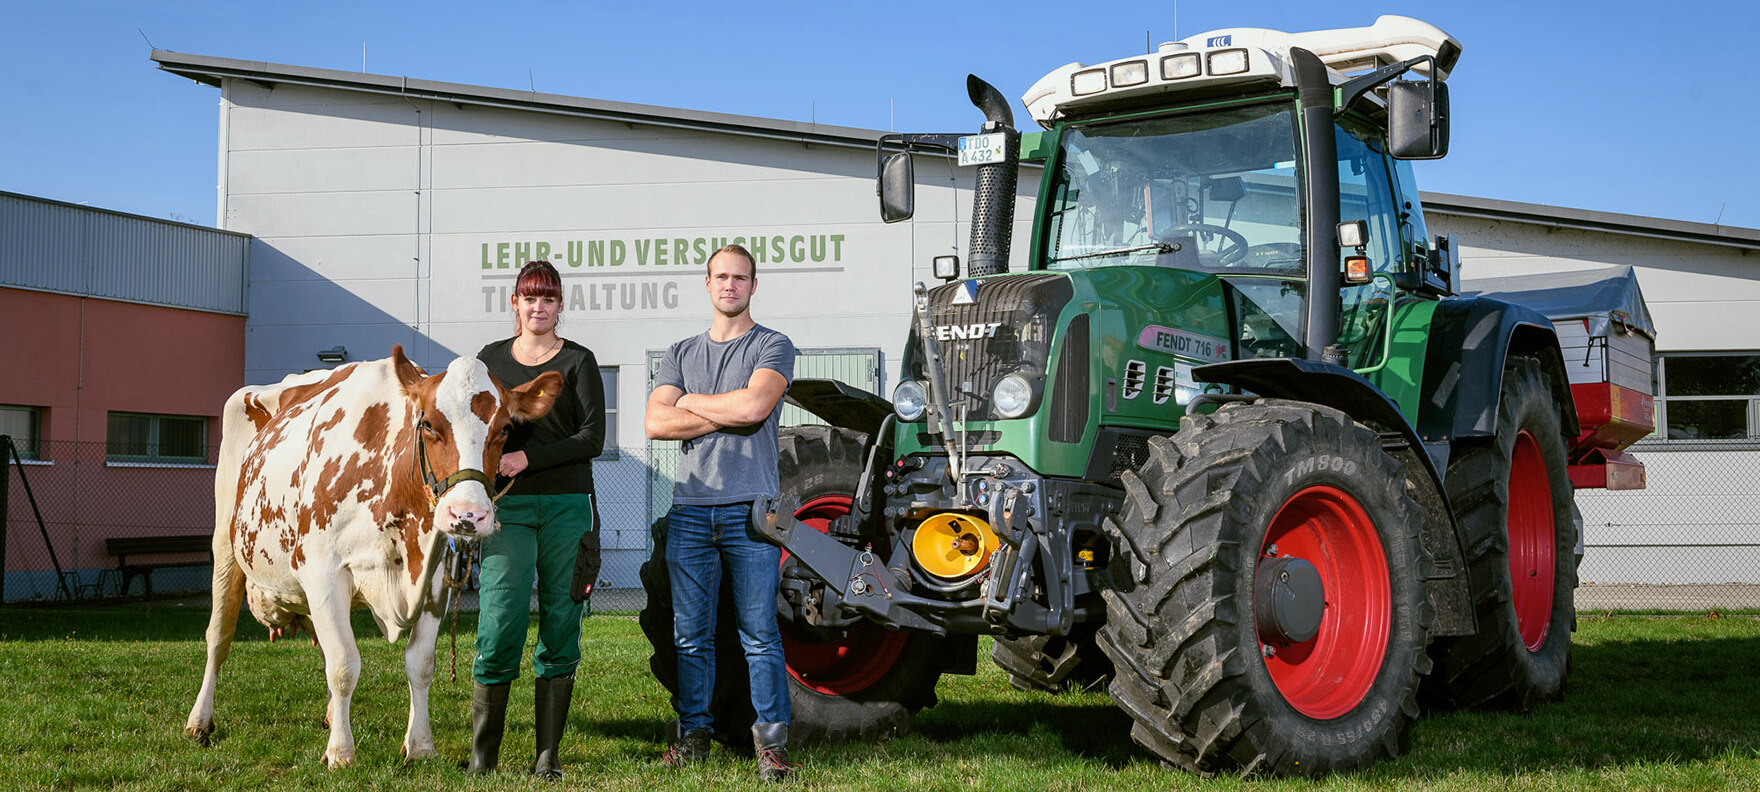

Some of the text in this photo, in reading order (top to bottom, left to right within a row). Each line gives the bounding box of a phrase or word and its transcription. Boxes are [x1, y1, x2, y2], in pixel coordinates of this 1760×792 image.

[967, 137, 989, 150] TDO
[961, 150, 992, 164] A 432
[481, 281, 679, 313] TIALTUNG
[934, 322, 1002, 341] ENDT
[1156, 331, 1192, 352] FENDT
[1195, 340, 1211, 356] 716
[1284, 454, 1356, 486] TM800
